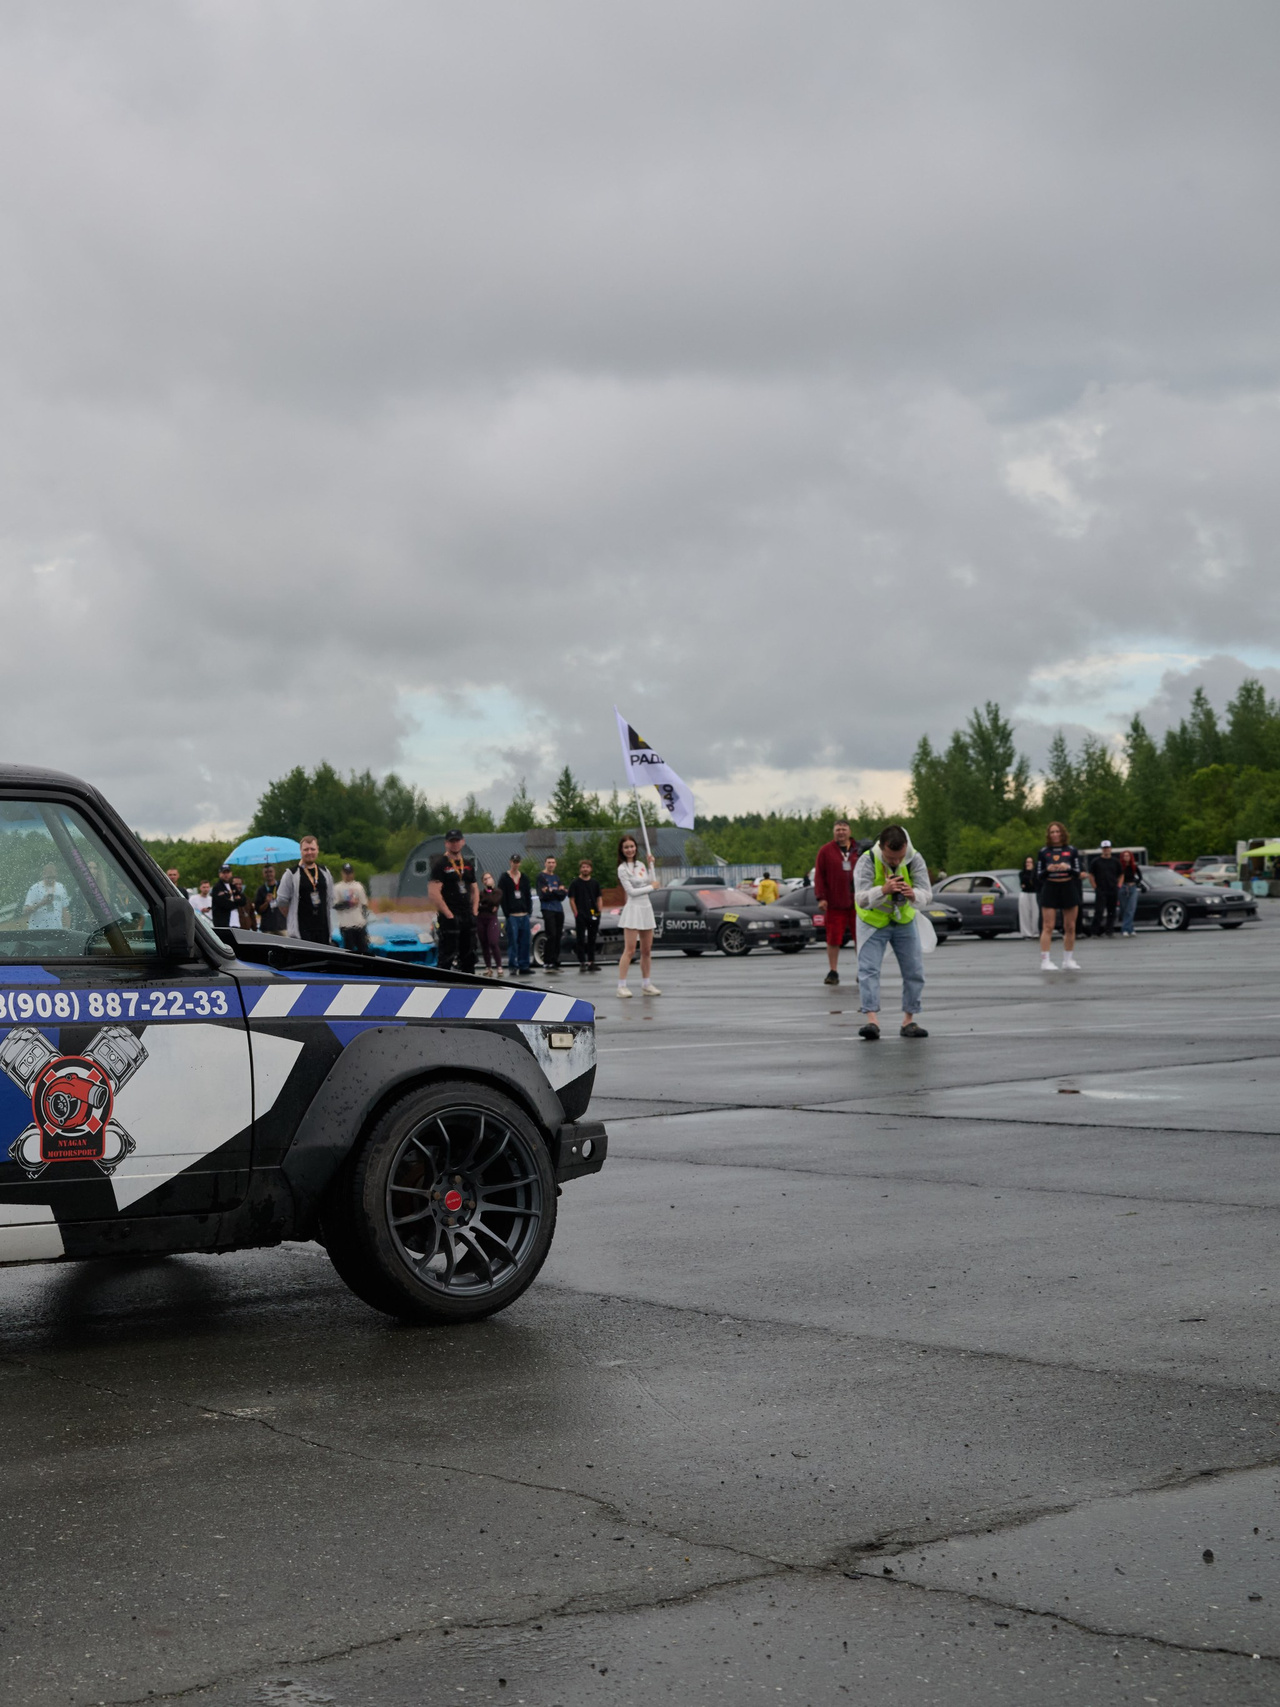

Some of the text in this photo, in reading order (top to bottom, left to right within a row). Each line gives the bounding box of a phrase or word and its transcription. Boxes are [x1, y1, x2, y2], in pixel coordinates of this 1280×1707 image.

[88, 990, 229, 1018] 887-22-33
[58, 1139, 88, 1147] NYAGAN
[47, 1149, 98, 1158] MOTORSPORT
